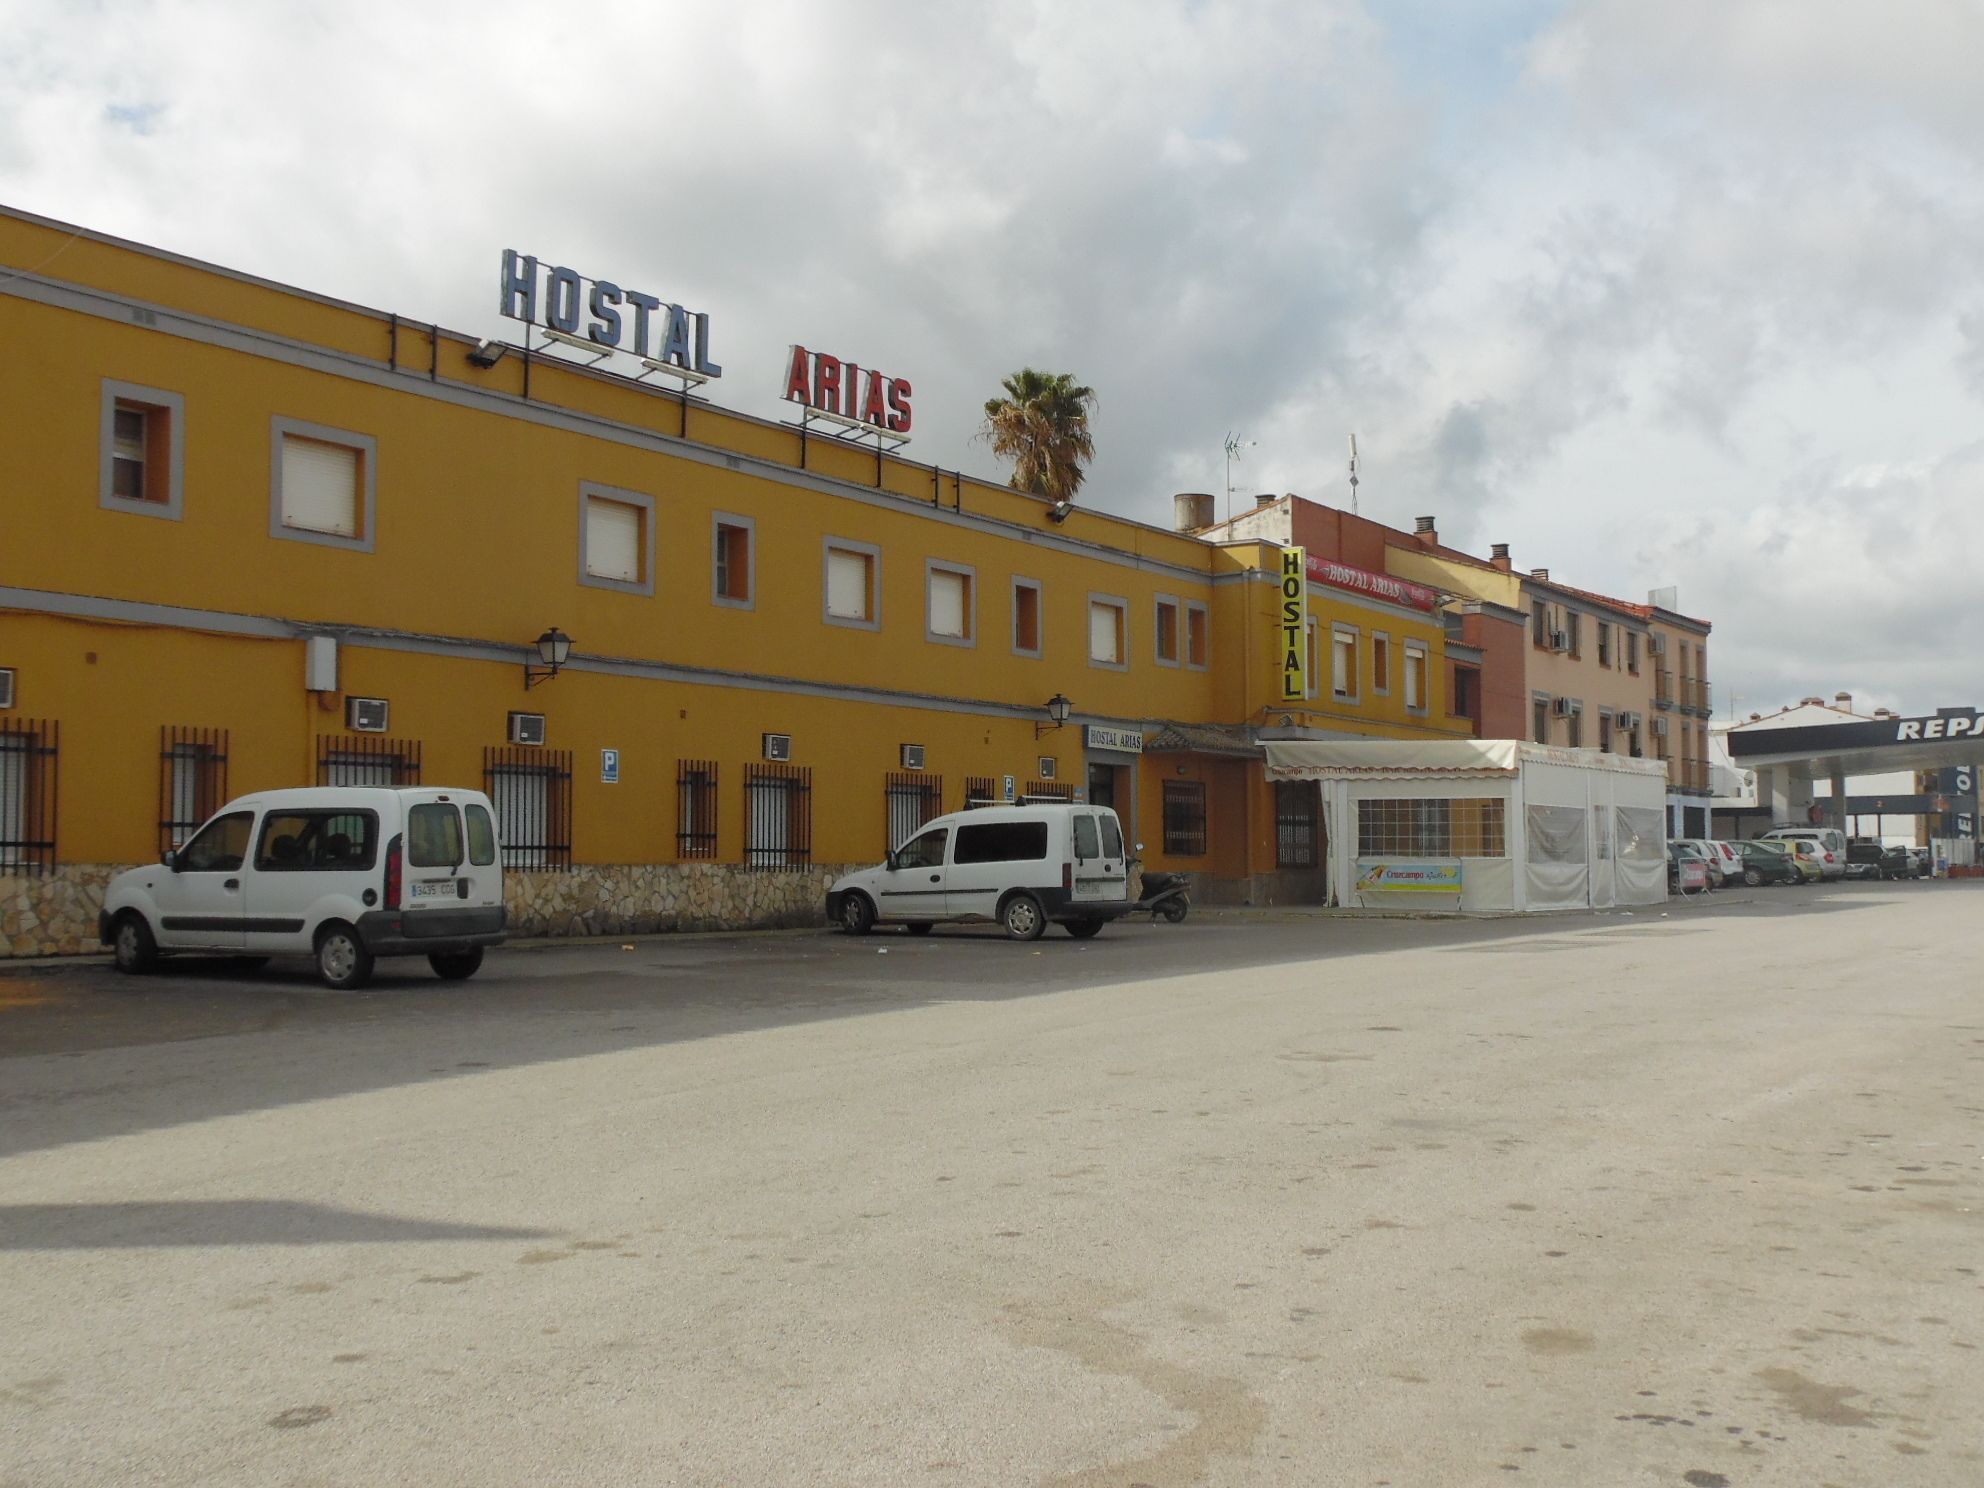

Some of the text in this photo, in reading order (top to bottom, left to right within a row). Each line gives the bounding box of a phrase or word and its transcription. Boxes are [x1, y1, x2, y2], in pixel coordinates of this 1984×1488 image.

[500, 248, 912, 432] HOSTAL ARIAS
[1329, 565, 1369, 590] HOSTAL
[1370, 575, 1402, 598] ARIAS
[1283, 554, 1301, 696] HOSTAL
[1090, 729, 1141, 749] HOSTAL ARIAS
[605, 752, 614, 770] P
[1386, 870, 1424, 880] Cruzcampo
